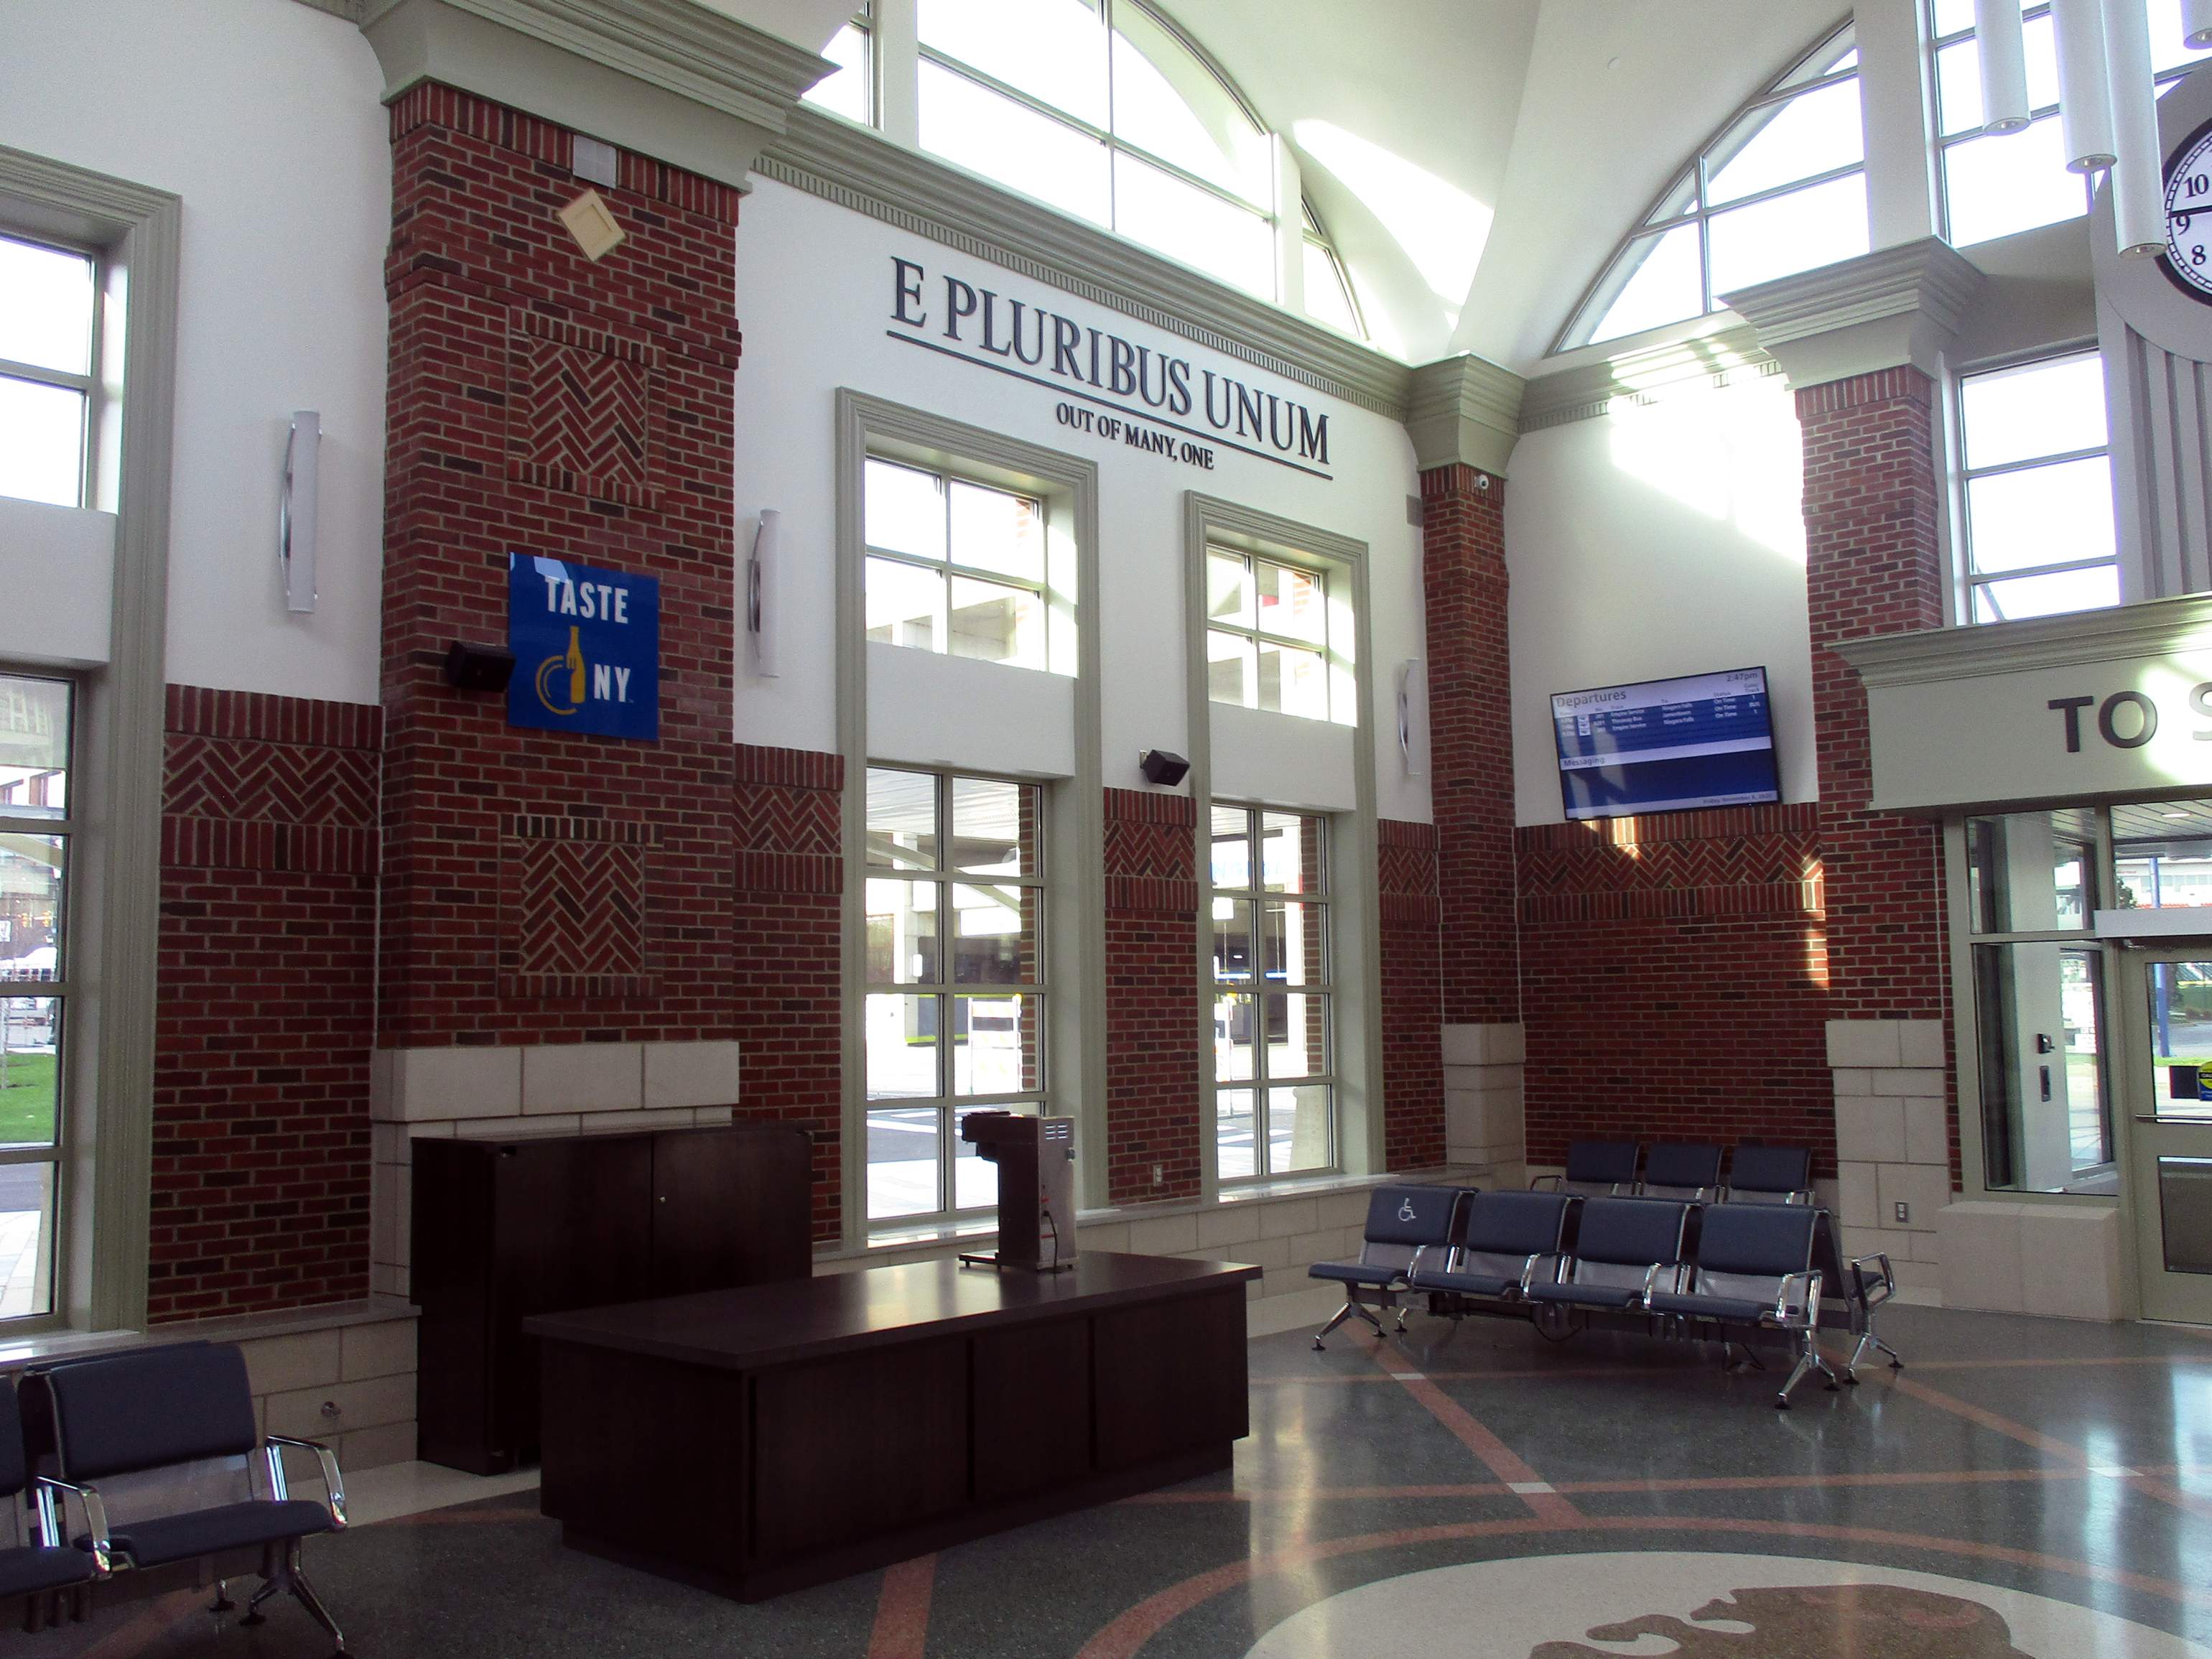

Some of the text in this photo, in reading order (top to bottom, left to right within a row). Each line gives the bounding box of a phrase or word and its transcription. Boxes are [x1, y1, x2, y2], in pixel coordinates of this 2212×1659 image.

[2184, 174, 2209, 198] 10
[2176, 214, 2190, 236] 9
[2191, 244, 2206, 266] 8
[890, 256, 1329, 465] E PLURIBUS UNUM
[1056, 402, 1214, 470] OUT OF MANY, ONE
[545, 575, 629, 624] TASTE
[593, 664, 631, 702] NY
[1556, 691, 1627, 708] Departures
[2048, 690, 2158, 753] TO
